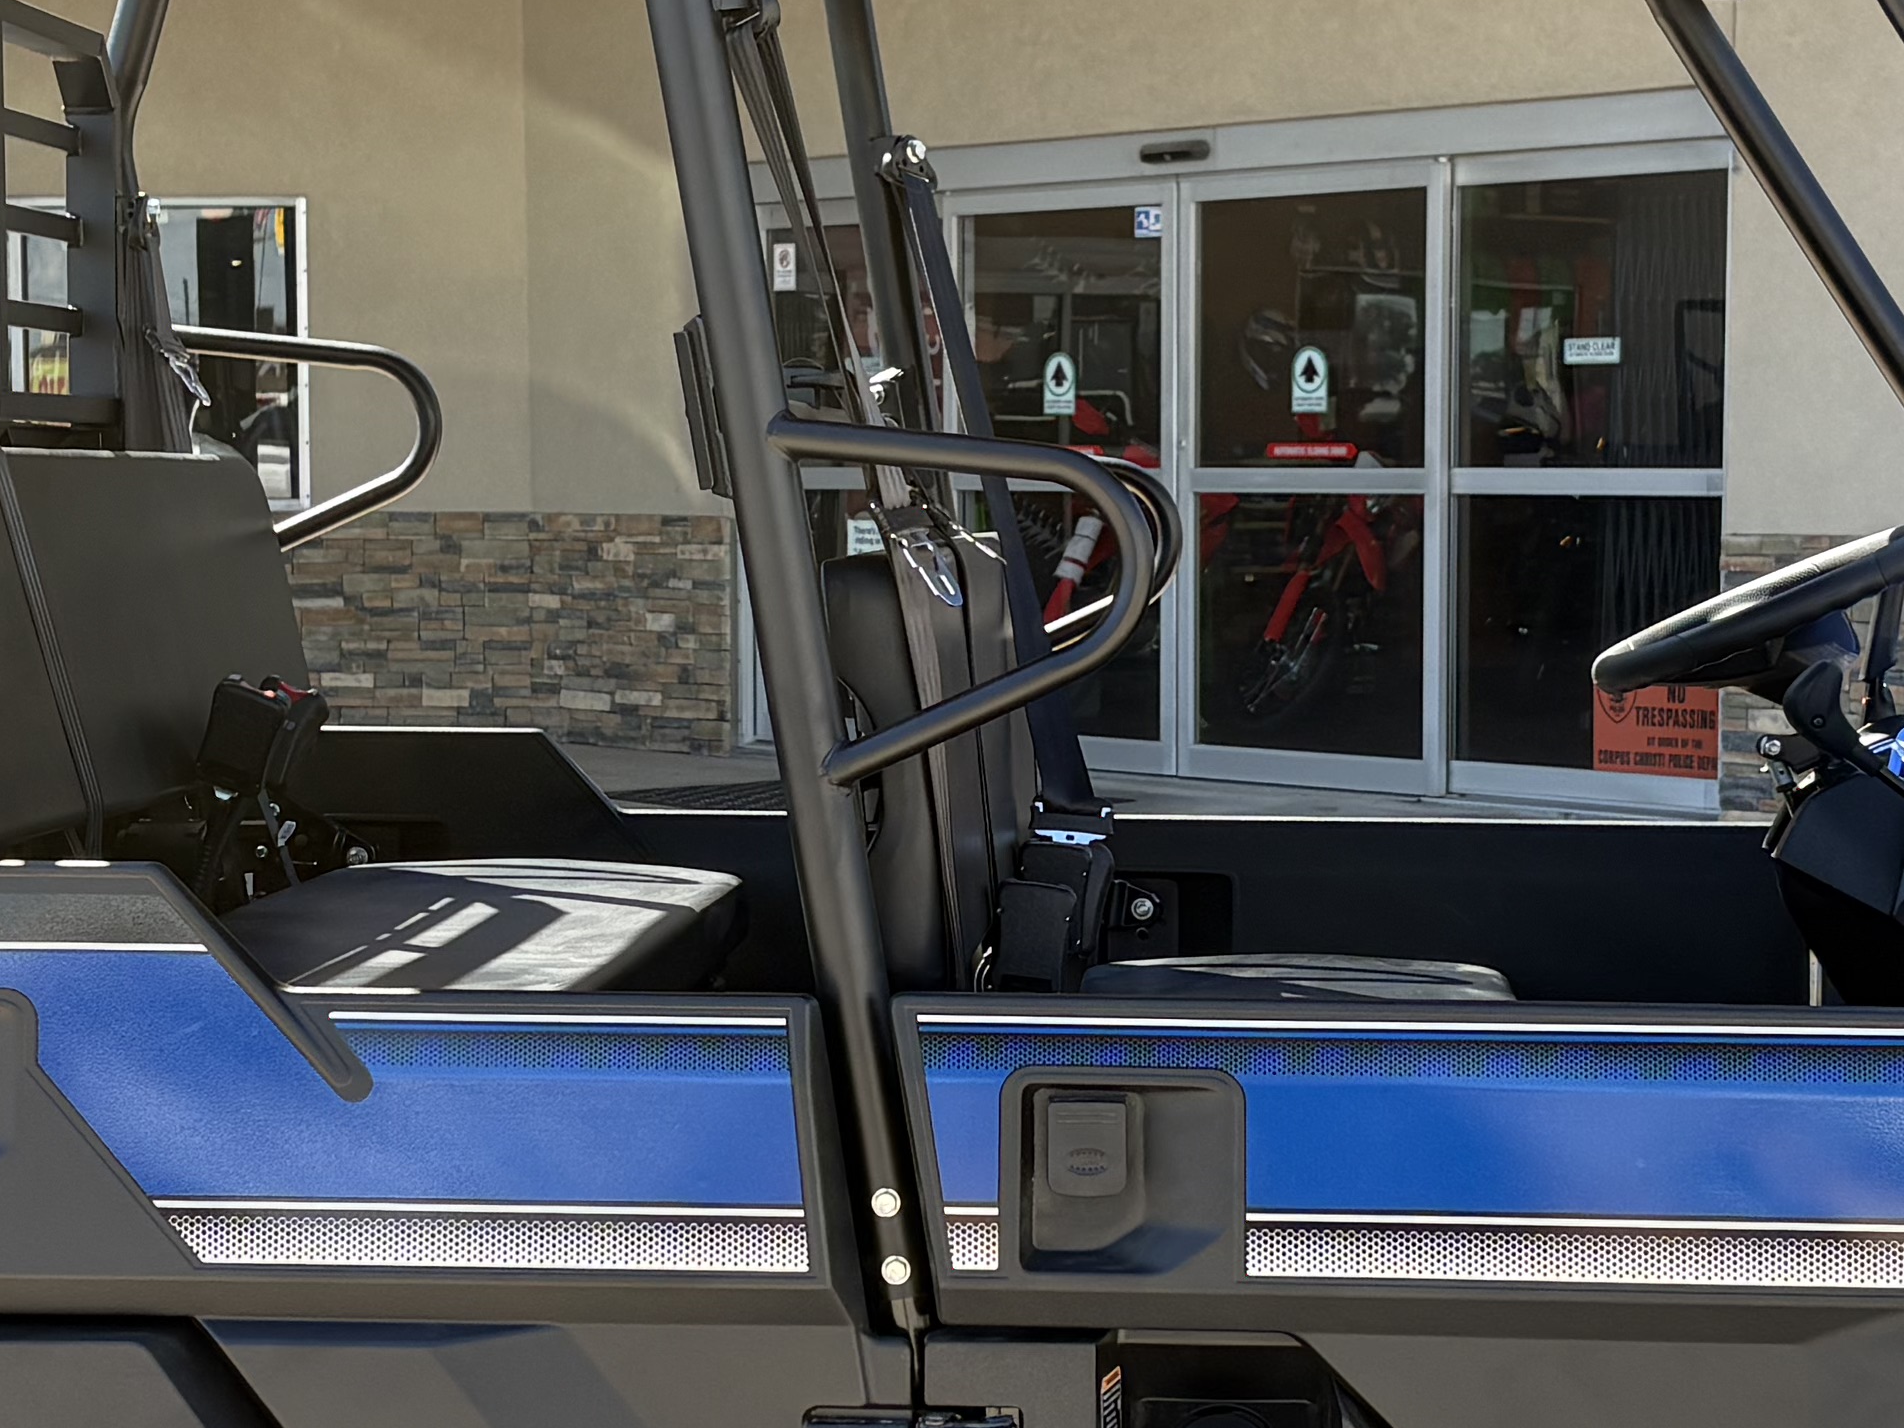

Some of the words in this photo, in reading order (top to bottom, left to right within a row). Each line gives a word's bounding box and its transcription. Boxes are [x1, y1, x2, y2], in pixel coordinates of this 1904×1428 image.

[1667, 685, 1686, 703] NO
[1635, 706, 1716, 730] TRESPASSING
[1599, 749, 1631, 766] CORPUS
[1634, 751, 1666, 768] CHRISTI
[1668, 753, 1695, 770] POLICE
